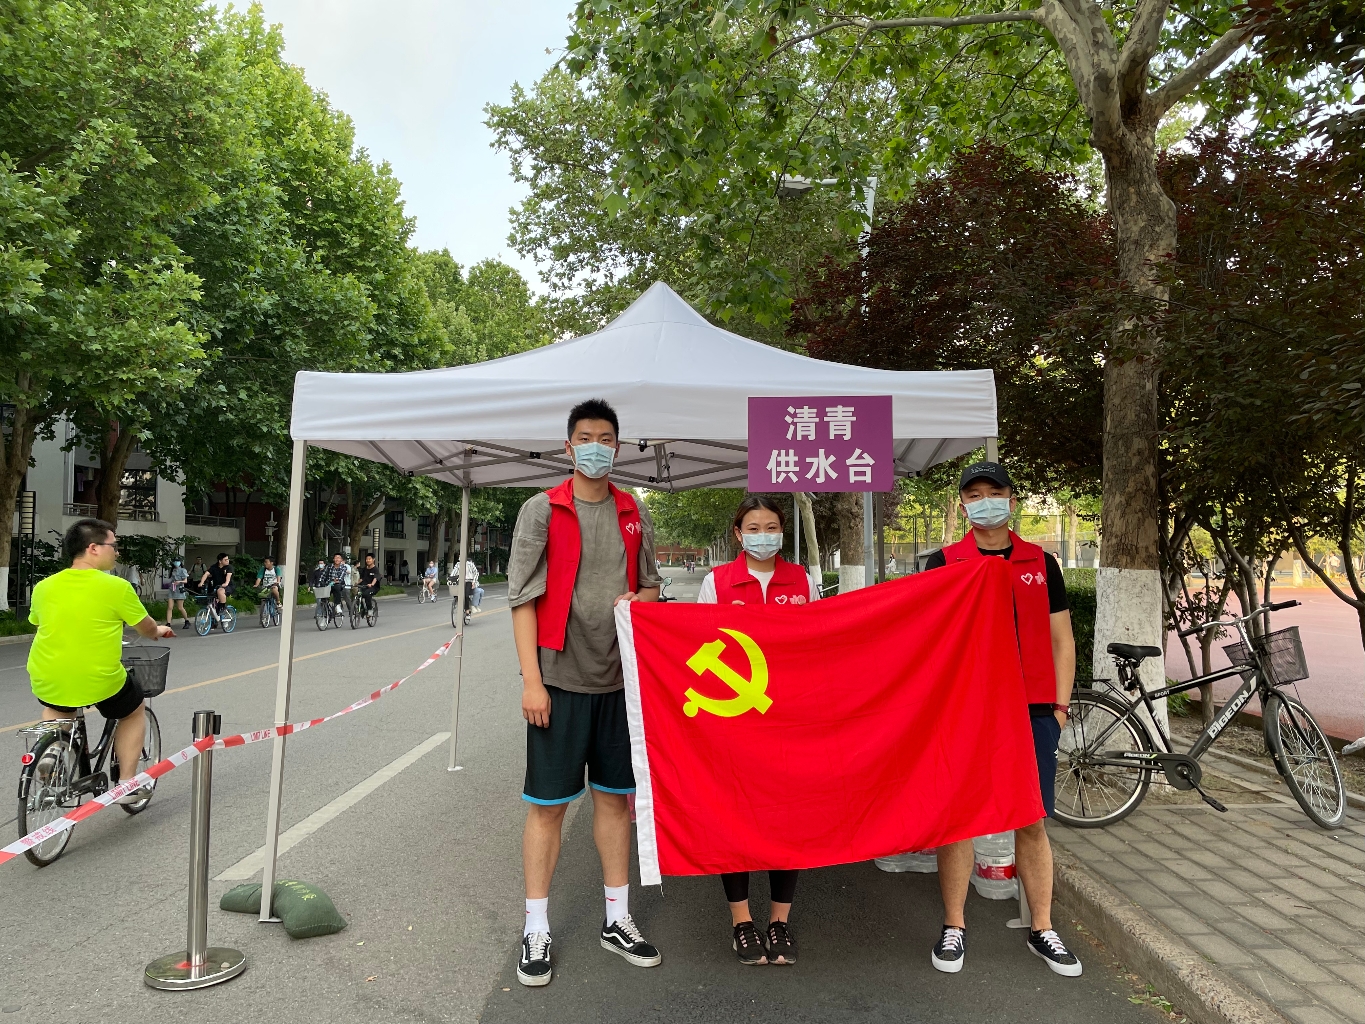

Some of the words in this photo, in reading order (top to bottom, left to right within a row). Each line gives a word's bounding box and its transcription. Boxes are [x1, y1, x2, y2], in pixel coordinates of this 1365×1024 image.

[784, 405, 857, 440] 清青
[766, 447, 876, 484] 供水台
[1154, 689, 1170, 698] SPORT
[1206, 689, 1250, 739] PIGEON
